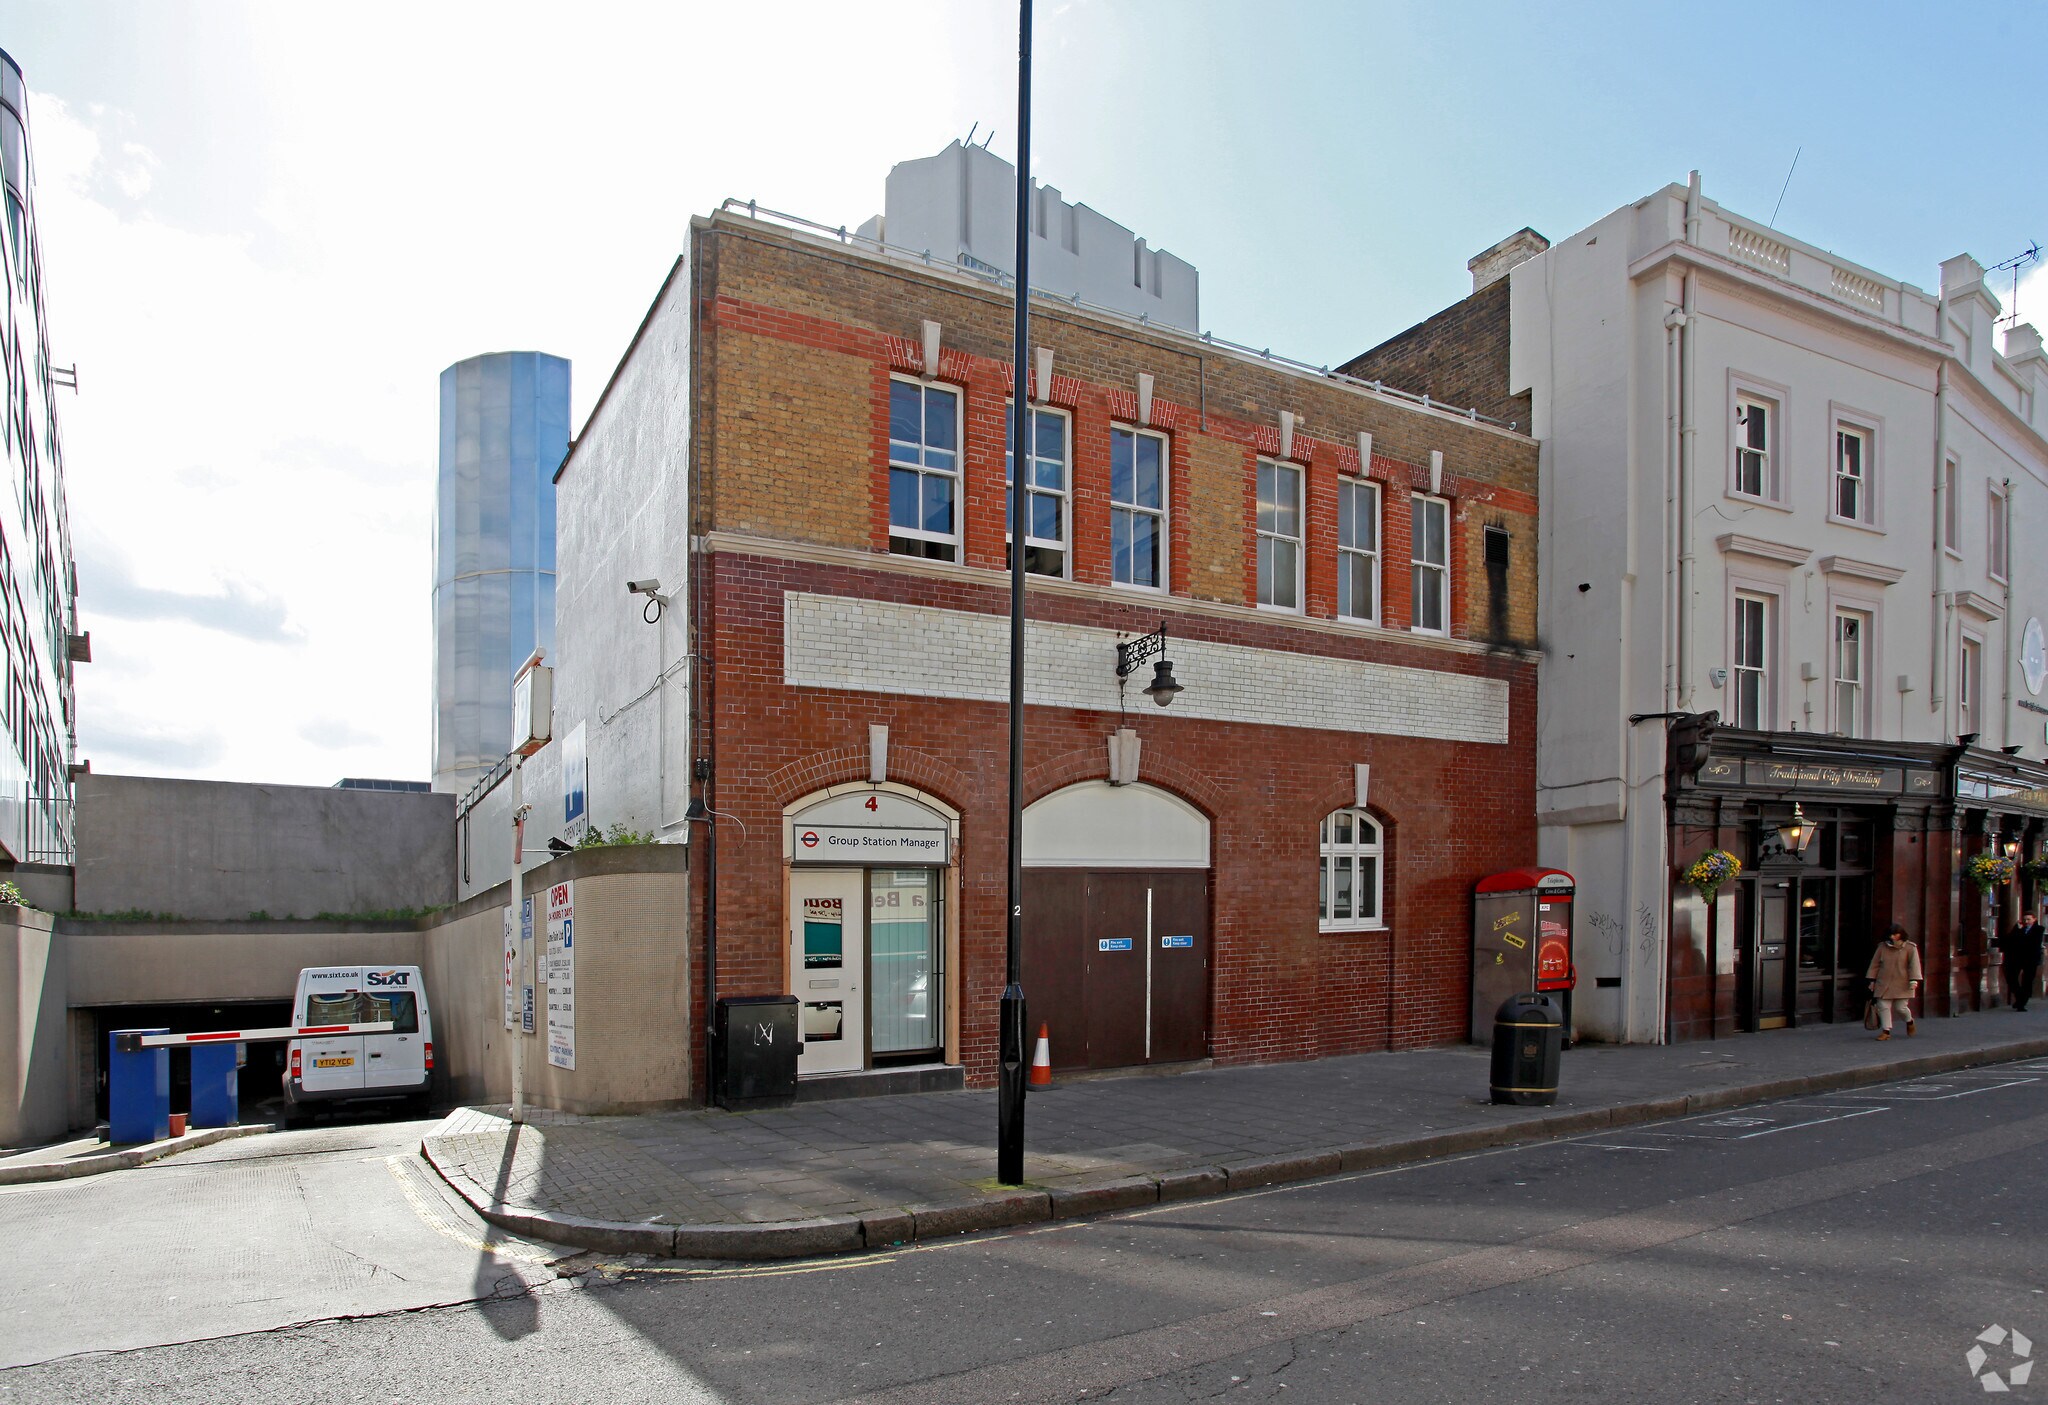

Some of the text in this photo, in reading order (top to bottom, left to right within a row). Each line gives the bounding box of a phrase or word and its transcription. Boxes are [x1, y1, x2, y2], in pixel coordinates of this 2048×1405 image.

[1822, 769, 1841, 786] City
[1843, 768, 1881, 788] Drinking
[864, 796, 878, 812] 4
[564, 821, 575, 842] OPEN
[828, 835, 940, 849] Group Station Manager
[550, 883, 569, 908] OPEN
[552, 909, 562, 919] HOURS
[564, 907, 573, 917] DAYS
[1014, 905, 1021, 916] 2
[565, 923, 571, 945] P
[311, 971, 359, 979] www.sixt.co.uk
[319, 1058, 351, 1067] YT12 YCC
